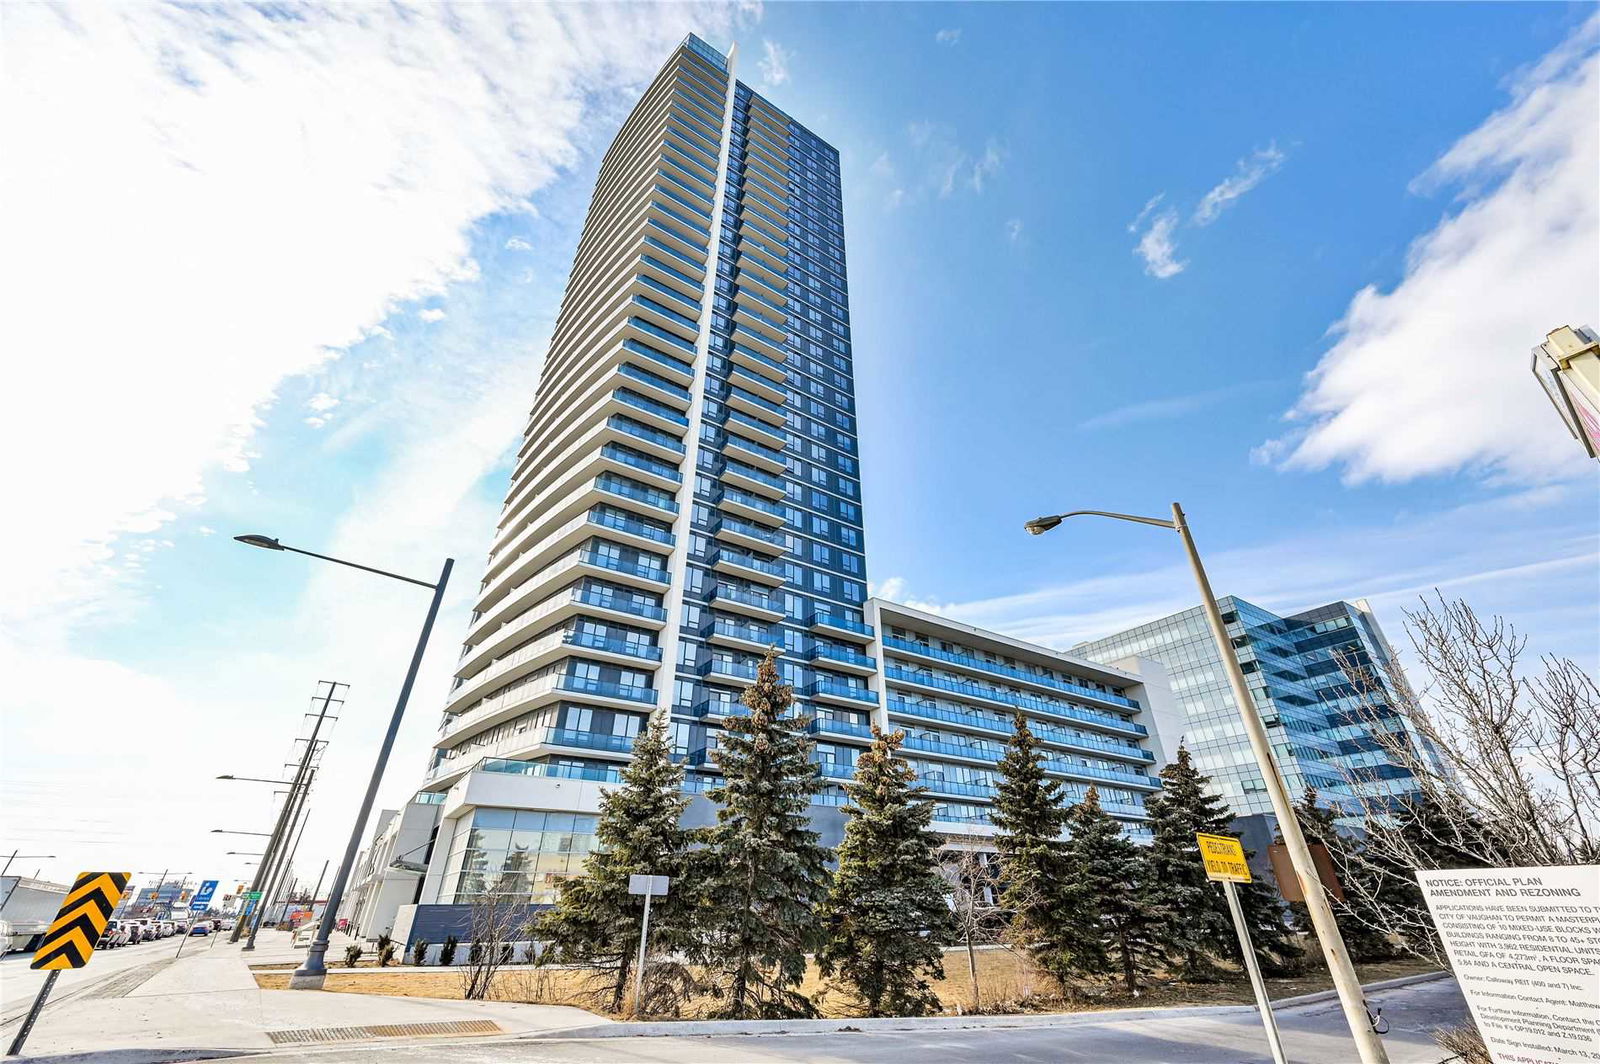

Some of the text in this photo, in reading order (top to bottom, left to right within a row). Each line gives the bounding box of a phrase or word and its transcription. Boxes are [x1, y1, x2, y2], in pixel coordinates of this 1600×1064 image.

[1465, 878, 1511, 886] OFFICIAL
[1512, 877, 1543, 886] PLAN
[1520, 888, 1581, 897] REZONING
[1555, 926, 1591, 934] BLOCKS
[1519, 944, 1574, 953] RESIDENTIAL
[1550, 956, 1580, 964] FLOOR
[1498, 962, 1536, 971] CENTRAL
[1536, 965, 1561, 973] OPEN
[1482, 991, 1516, 1000] Information
[1517, 995, 1544, 1003] Contact
[1553, 1014, 1581, 1024] Contact
[1522, 1019, 1552, 1029] Planning
[1553, 1023, 1595, 1035] Department
[1507, 1039, 1521, 1048] Sign
[1554, 1046, 1577, 1056] March
[1497, 1053, 1515, 1062] THIS
